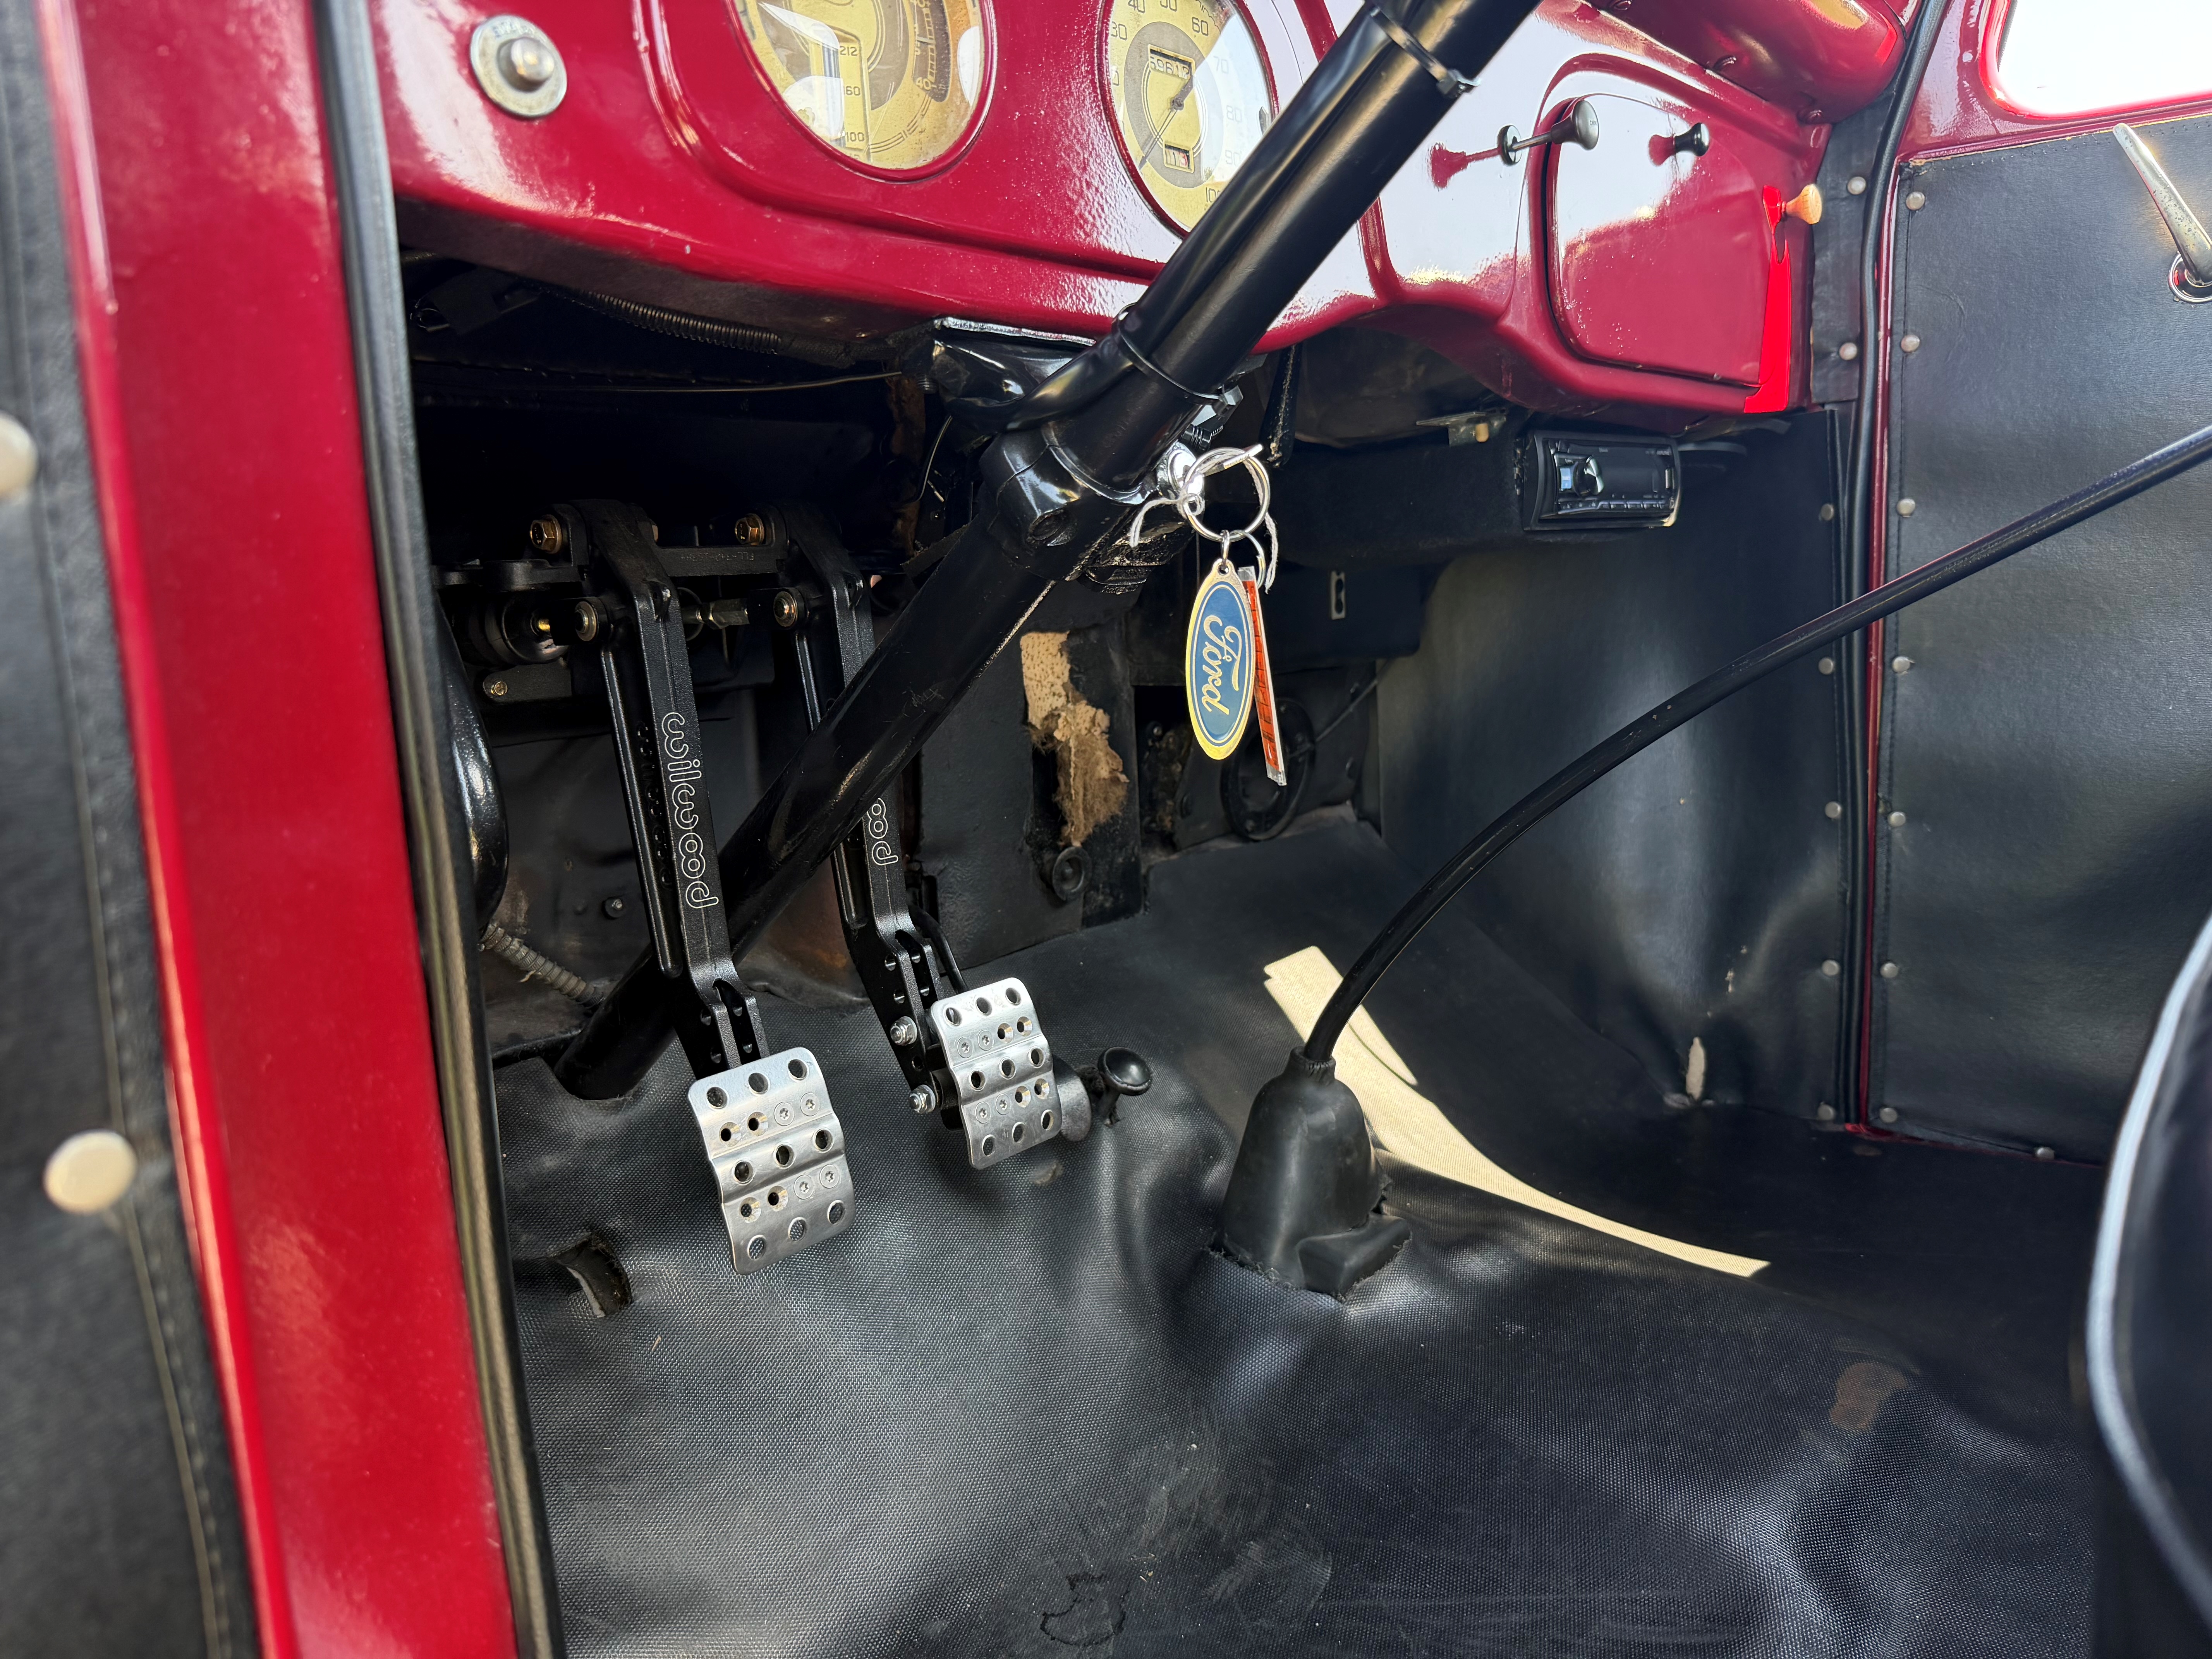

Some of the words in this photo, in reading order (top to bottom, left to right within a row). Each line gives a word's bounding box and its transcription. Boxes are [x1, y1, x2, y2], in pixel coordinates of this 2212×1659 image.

[1111, 21, 1127, 40] 30
[1192, 16, 1209, 36] 60
[839, 45, 857, 57] 212
[1213, 55, 1229, 74] 70
[1227, 105, 1242, 123] 80
[846, 131, 865, 142] 100
[1206, 187, 1221, 203] 10
[1202, 615, 1242, 715] Ford
[661, 712, 719, 909] wilwood
